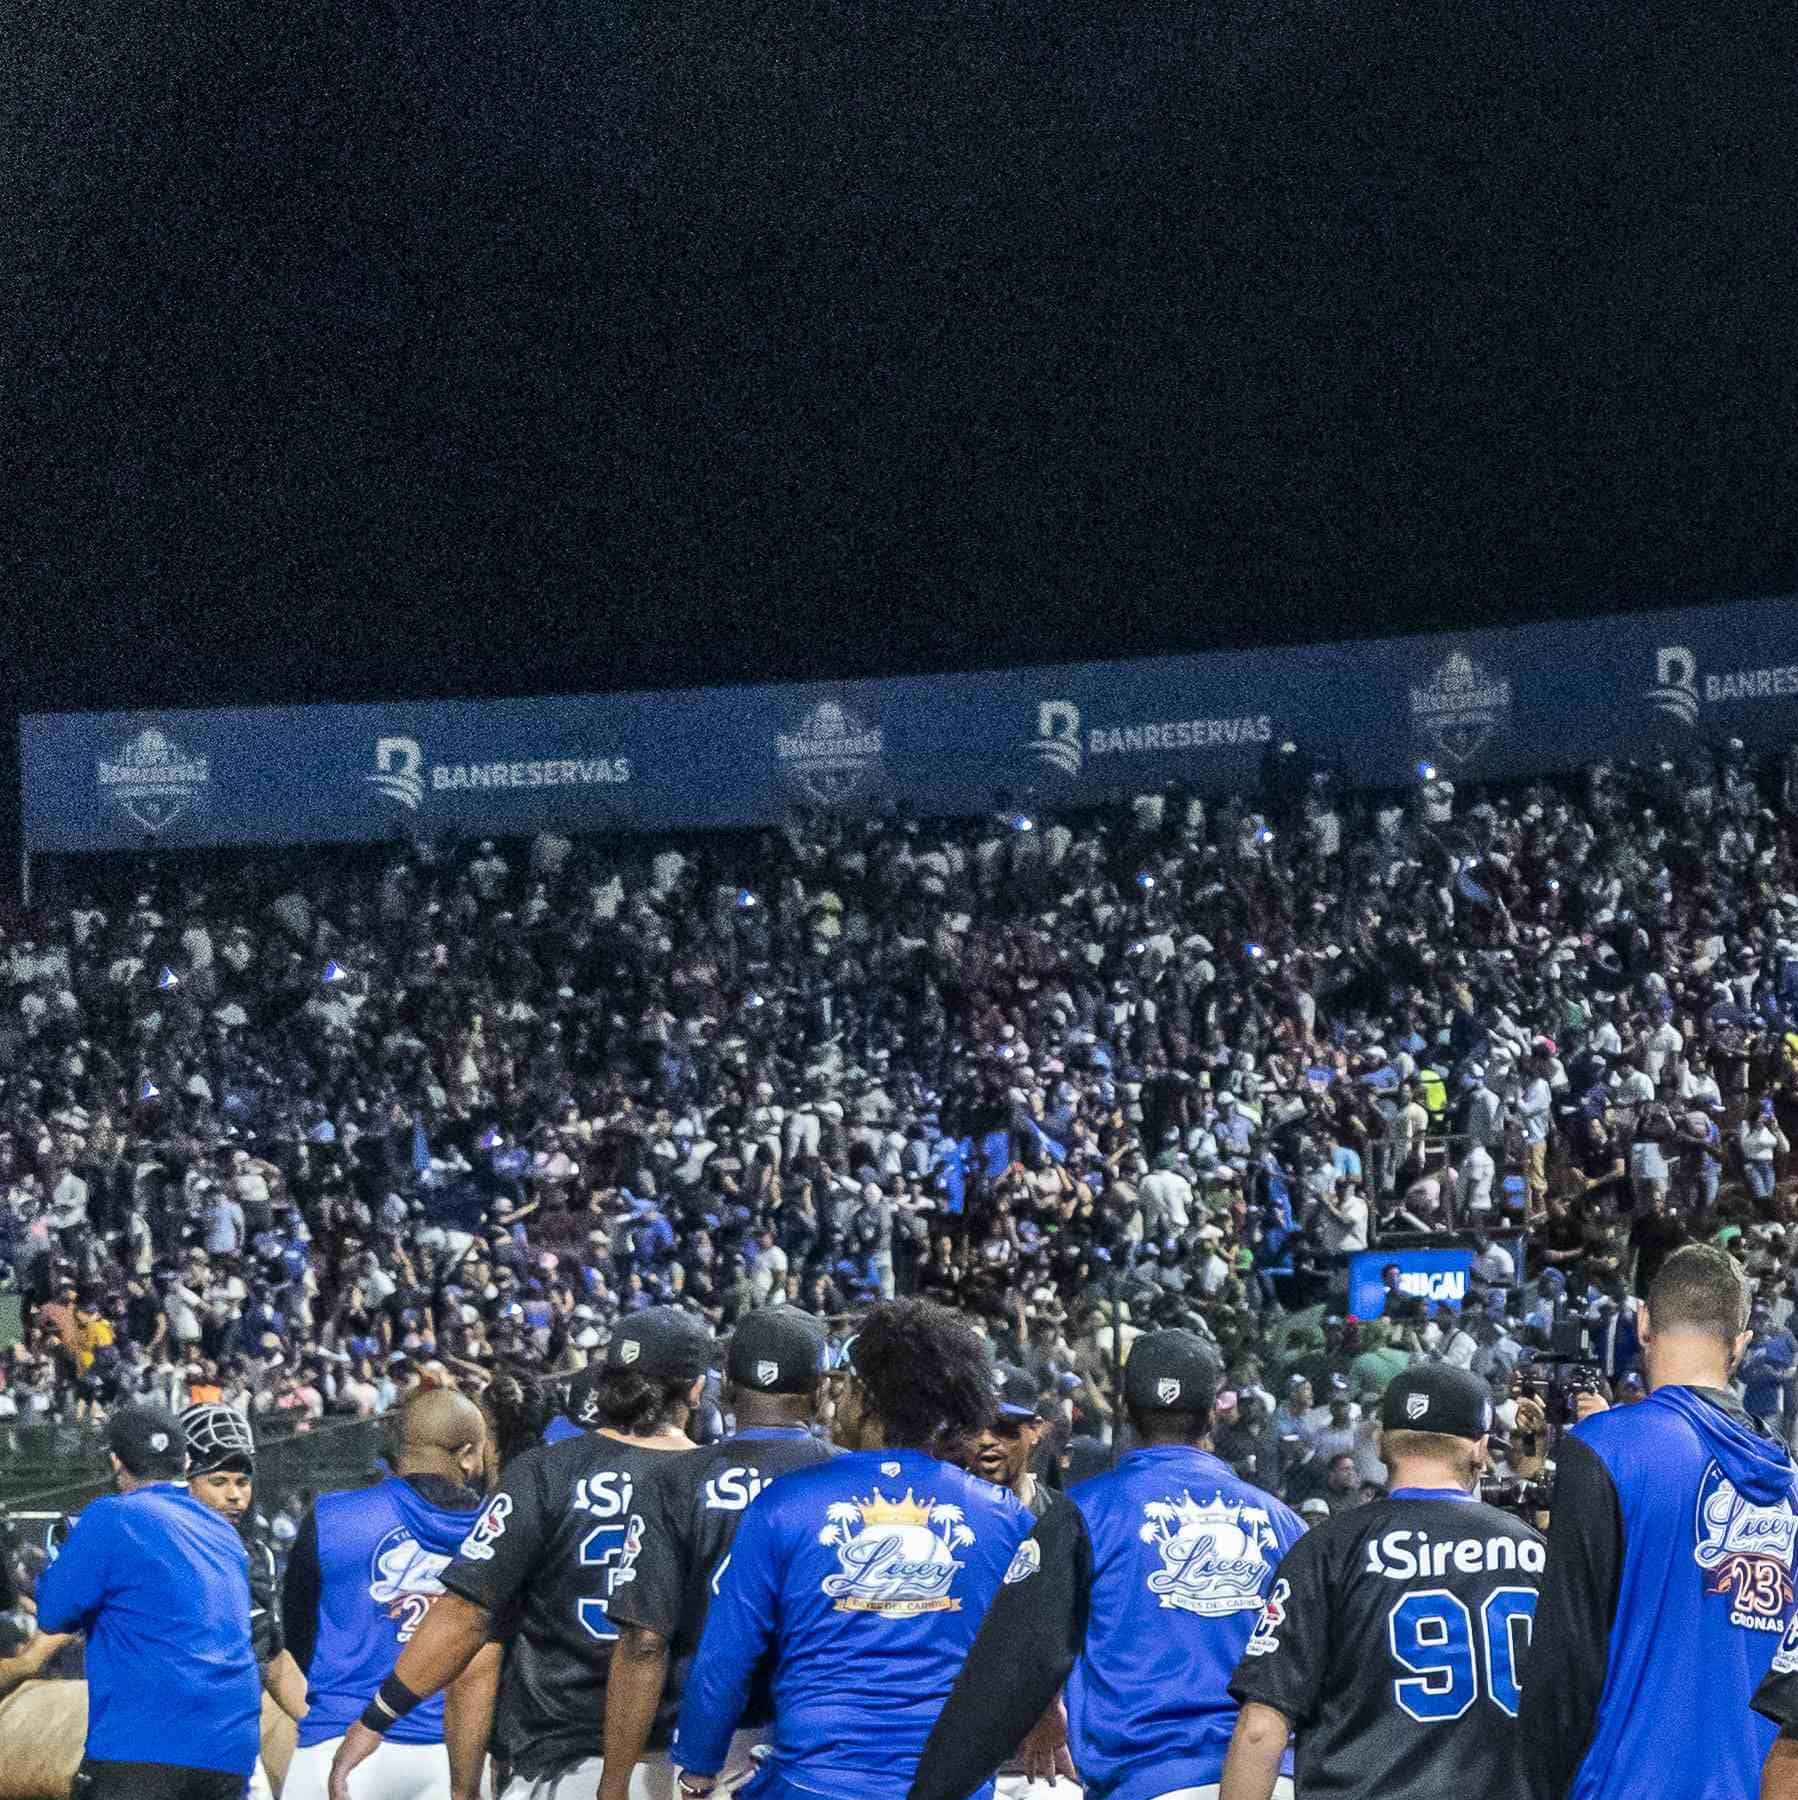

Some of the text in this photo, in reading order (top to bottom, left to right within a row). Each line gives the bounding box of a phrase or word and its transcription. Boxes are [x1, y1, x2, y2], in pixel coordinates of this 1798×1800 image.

[1090, 716, 1271, 756] BANRESERVAS
[431, 757, 629, 791] BANRESERVAS
[821, 1536, 965, 1599] Licey
[1147, 1535, 1272, 1595] Licey
[1381, 1530, 1546, 1580] Sirena
[1730, 1556, 1783, 1617] 23
[1388, 1586, 1540, 1723] 90
